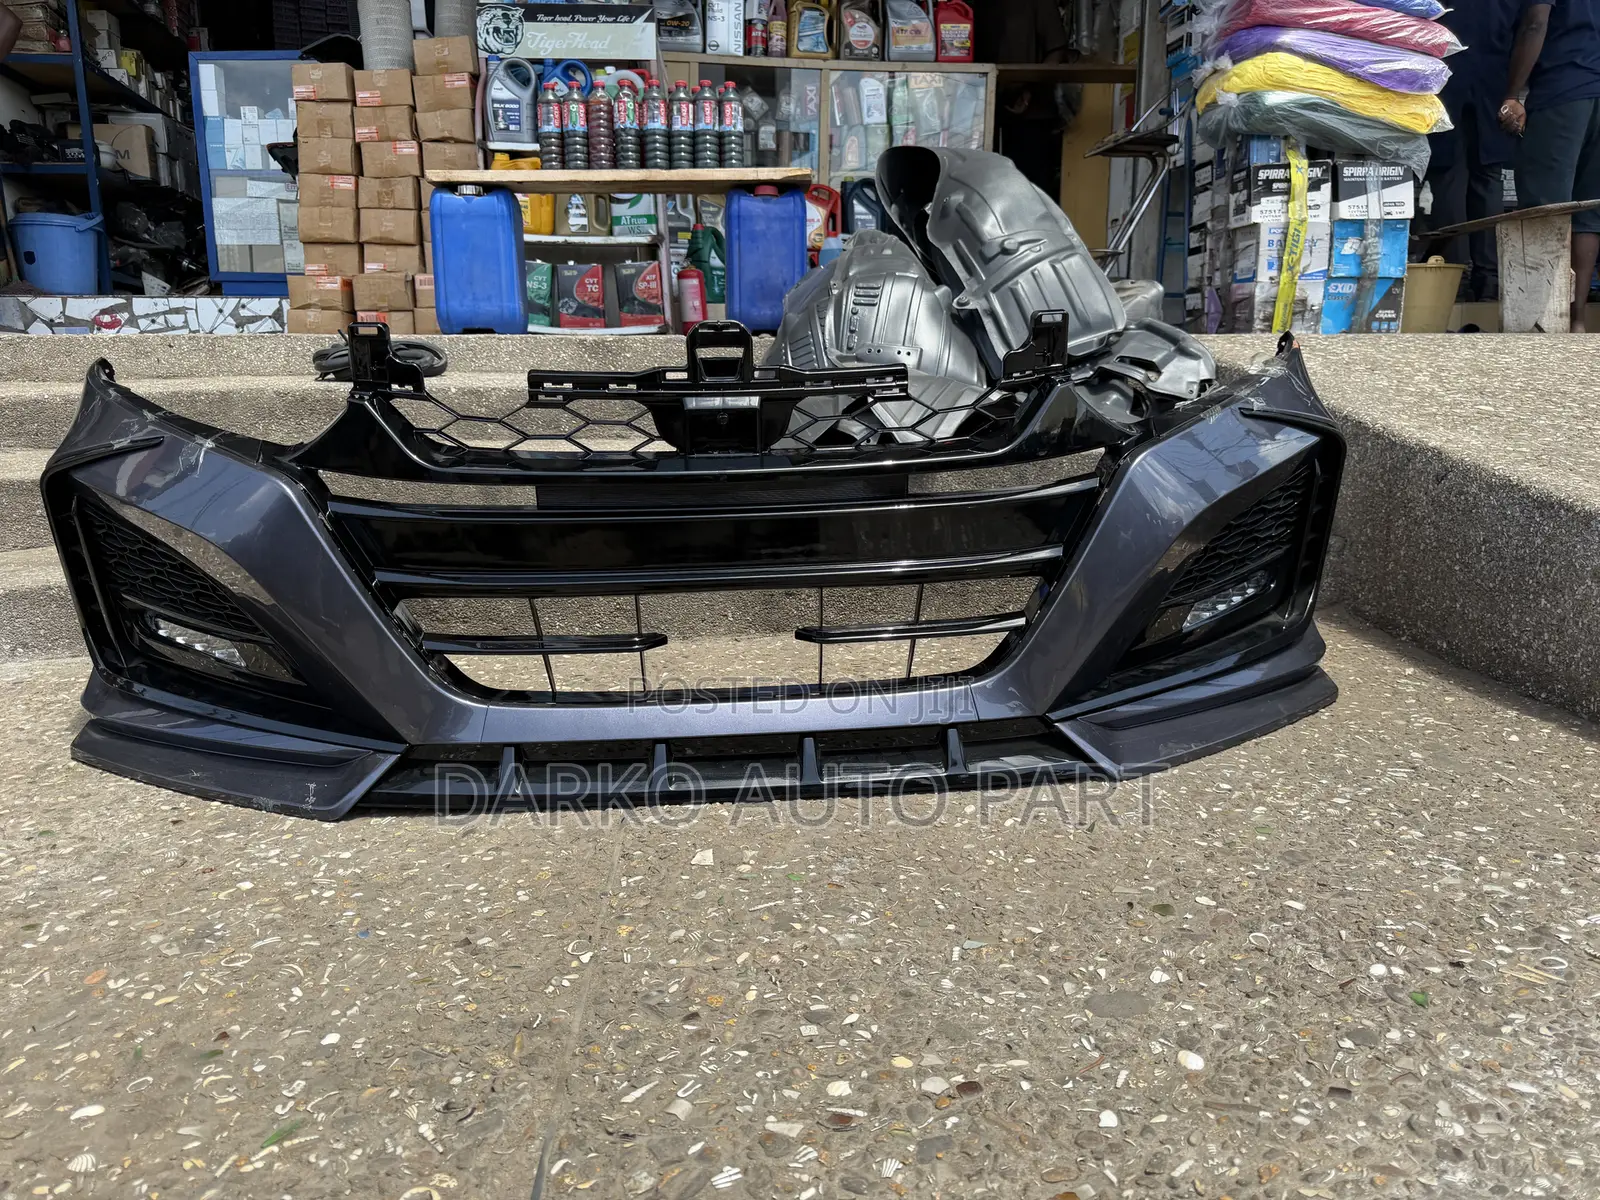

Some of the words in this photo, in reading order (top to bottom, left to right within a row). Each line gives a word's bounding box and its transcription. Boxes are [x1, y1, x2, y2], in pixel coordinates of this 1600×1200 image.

[574, 14, 596, 22] Power
[597, 14, 616, 23] Your
[733, 2, 742, 53] NISSAN
[914, 75, 940, 85] TAXI
[807, 85, 817, 116] TAXI
[1258, 168, 1291, 180] SPIRRA
[1343, 166, 1374, 177] SPIRRA
[620, 216, 631, 225] AT
[526, 281, 547, 289] NS-3
